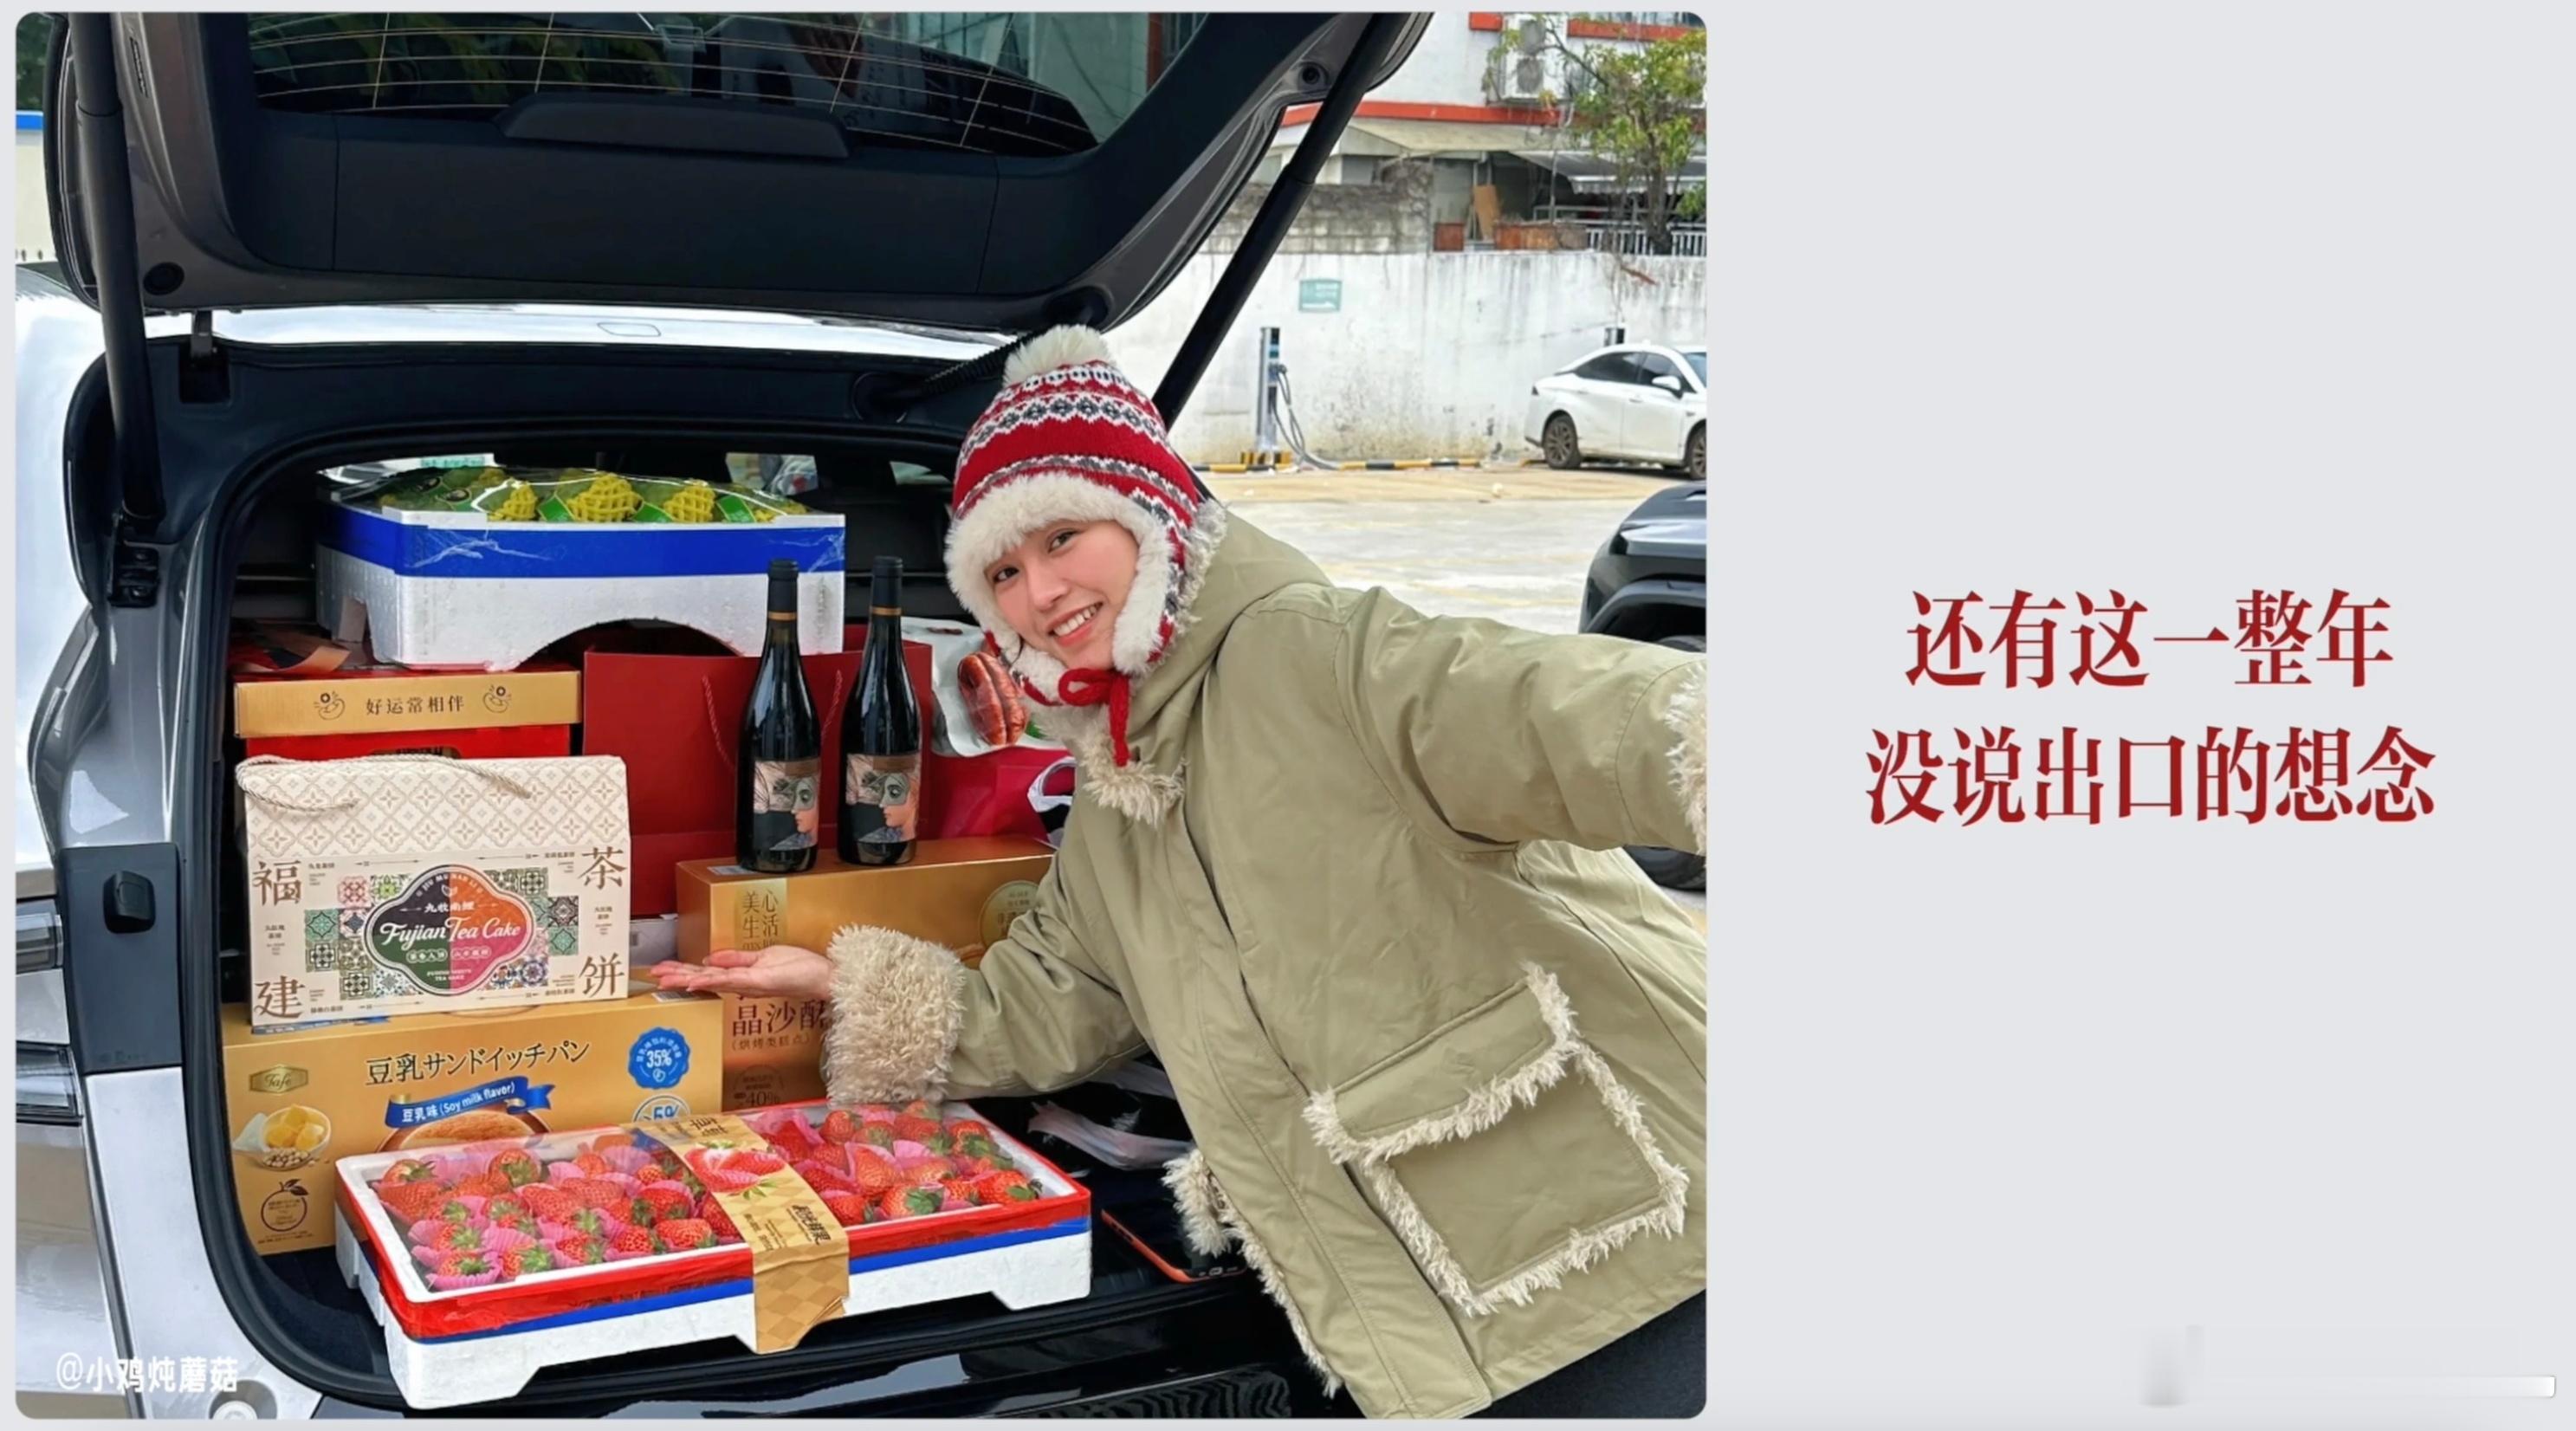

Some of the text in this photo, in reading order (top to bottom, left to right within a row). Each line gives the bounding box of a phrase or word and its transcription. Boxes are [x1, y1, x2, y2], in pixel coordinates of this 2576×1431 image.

[366, 696, 464, 715] 好运常相伴
[253, 859, 301, 906] 福
[578, 846, 627, 890] 茶
[379, 916, 521, 950] Fujian Tea Cake
[254, 975, 305, 1019] 建
[579, 953, 625, 998] 饼
[365, 1039, 591, 1086] 豆乳サンドイッチパン
[646, 1048, 673, 1068] 35%
[401, 1104, 438, 1123] 豆乳味
[462, 1093, 483, 1110] milk
[483, 1081, 515, 1100] flavor)
